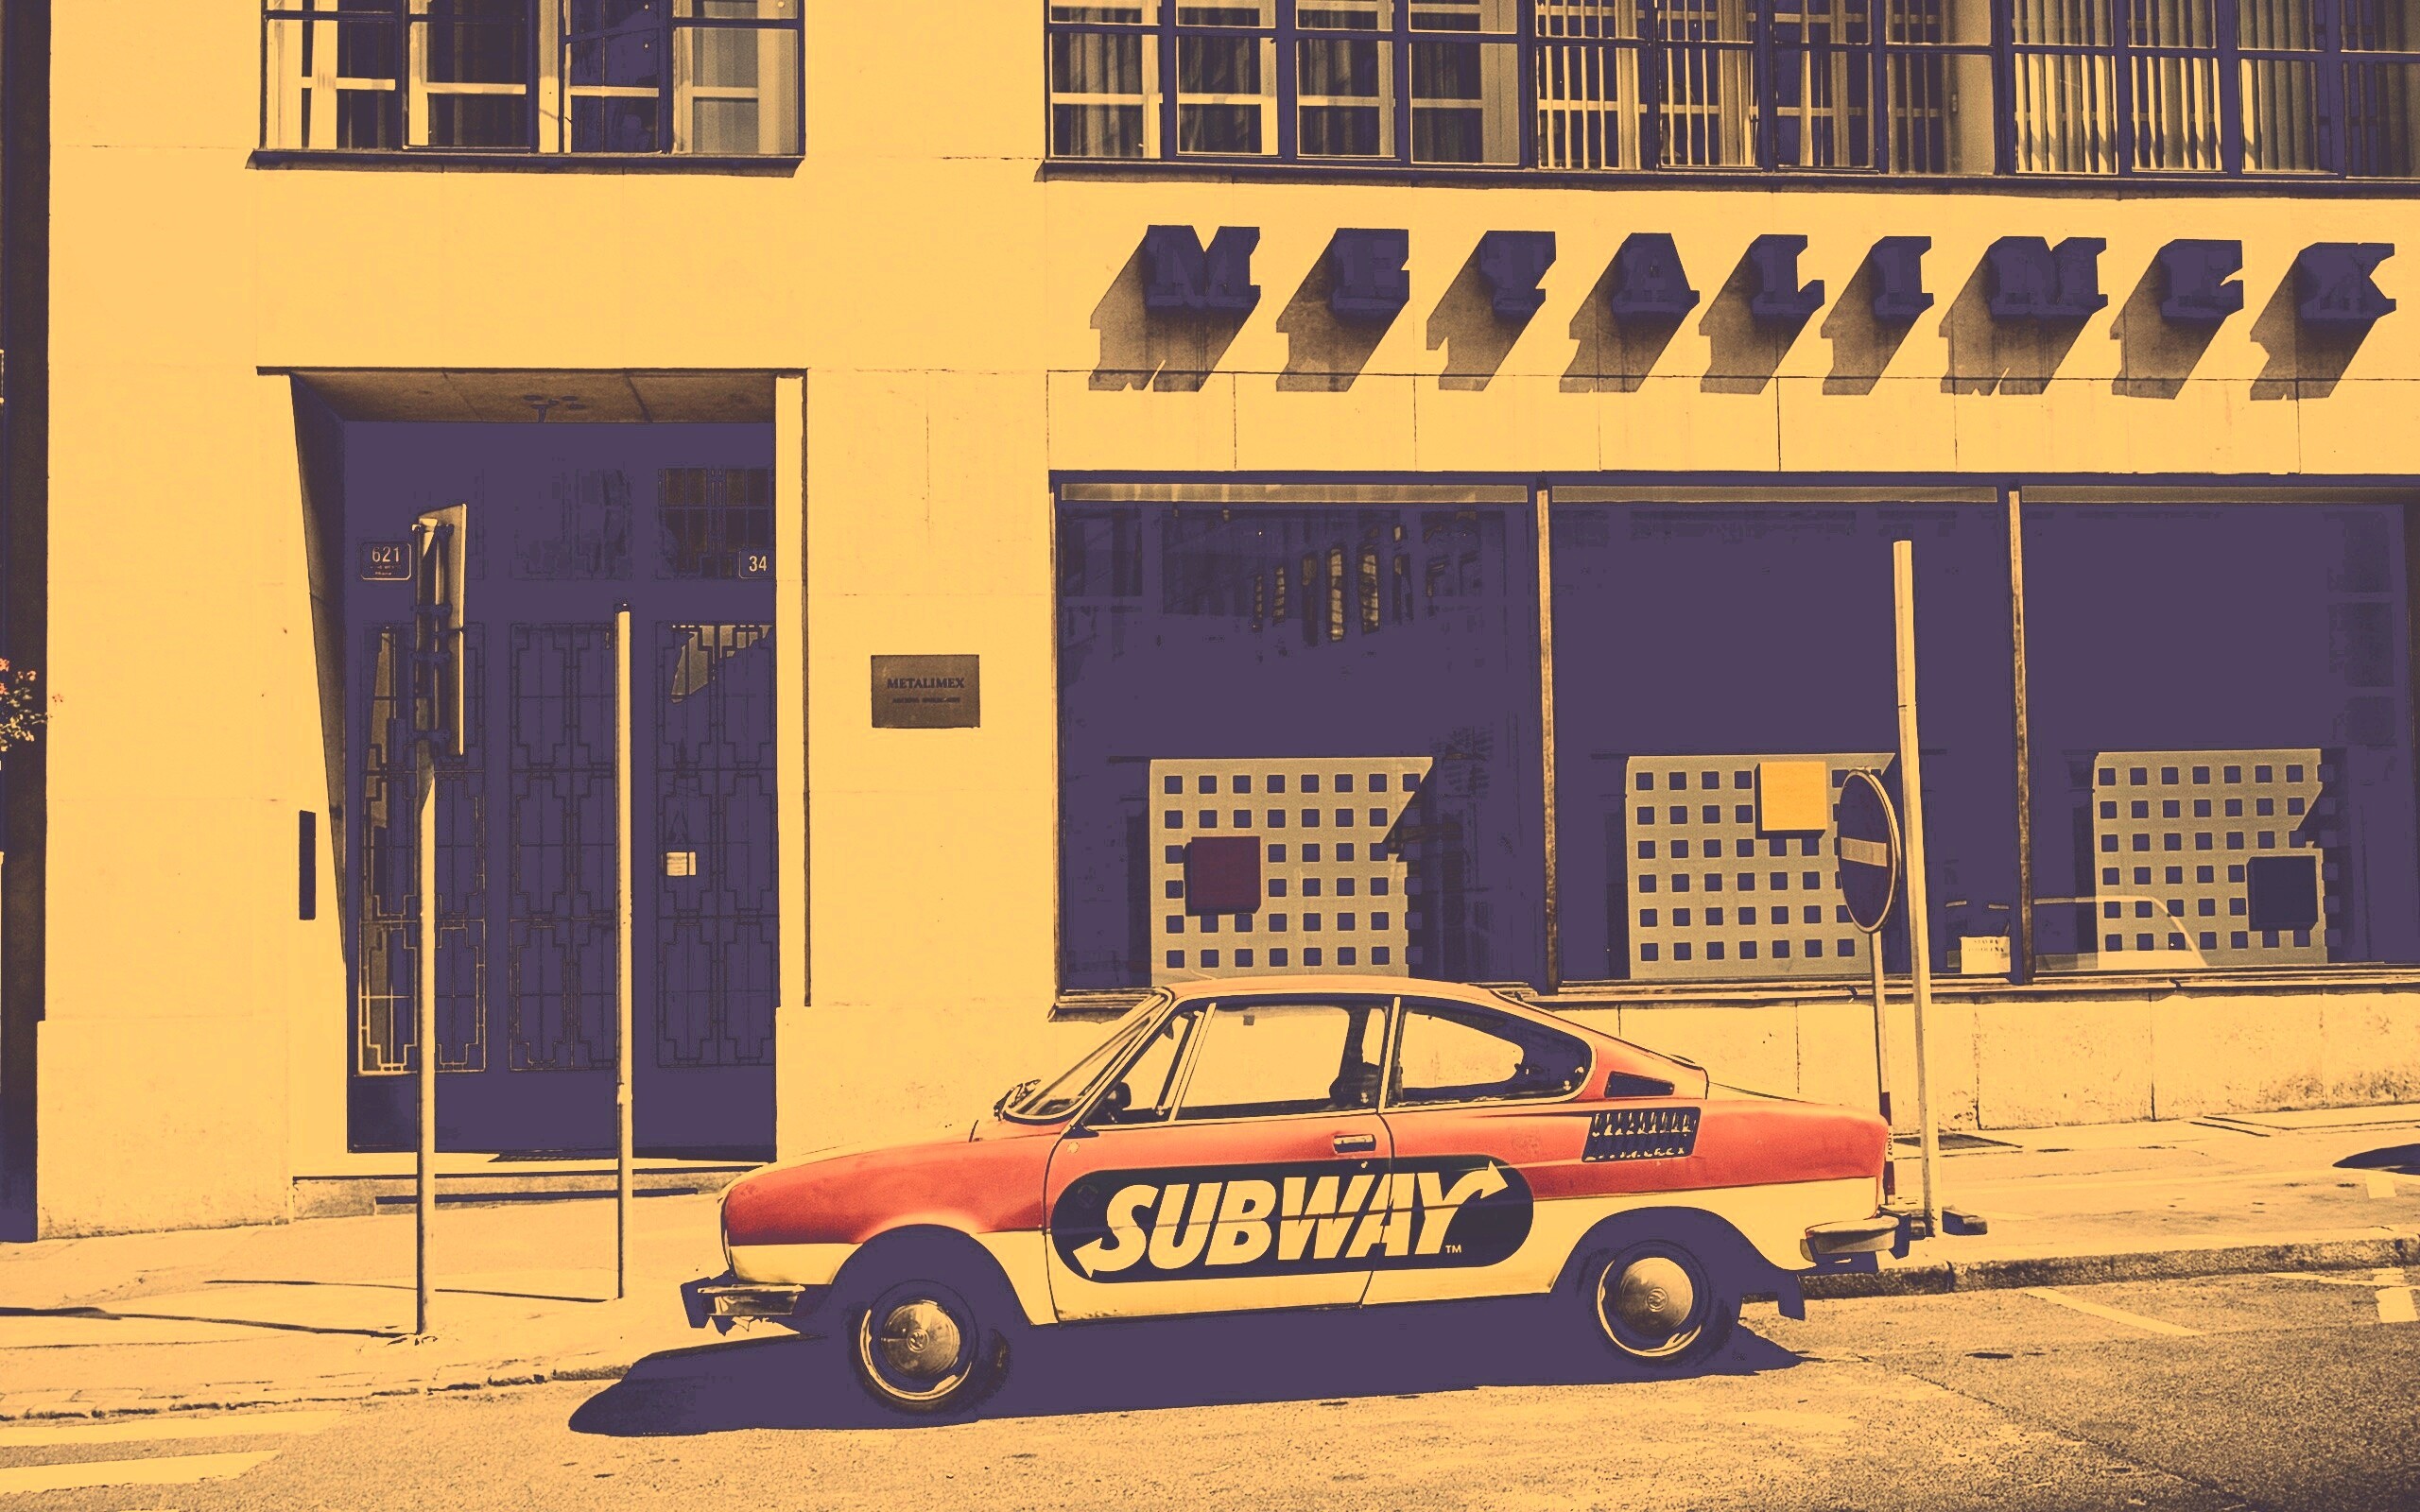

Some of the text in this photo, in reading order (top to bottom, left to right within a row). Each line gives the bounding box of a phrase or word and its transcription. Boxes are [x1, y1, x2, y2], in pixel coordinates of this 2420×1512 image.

[1144, 225, 2397, 323] METALIMEX
[372, 545, 401, 562] 621
[749, 555, 768, 572] 34
[887, 678, 965, 689] METALIMEX
[1073, 1160, 1509, 1278] SUBWAY TM
